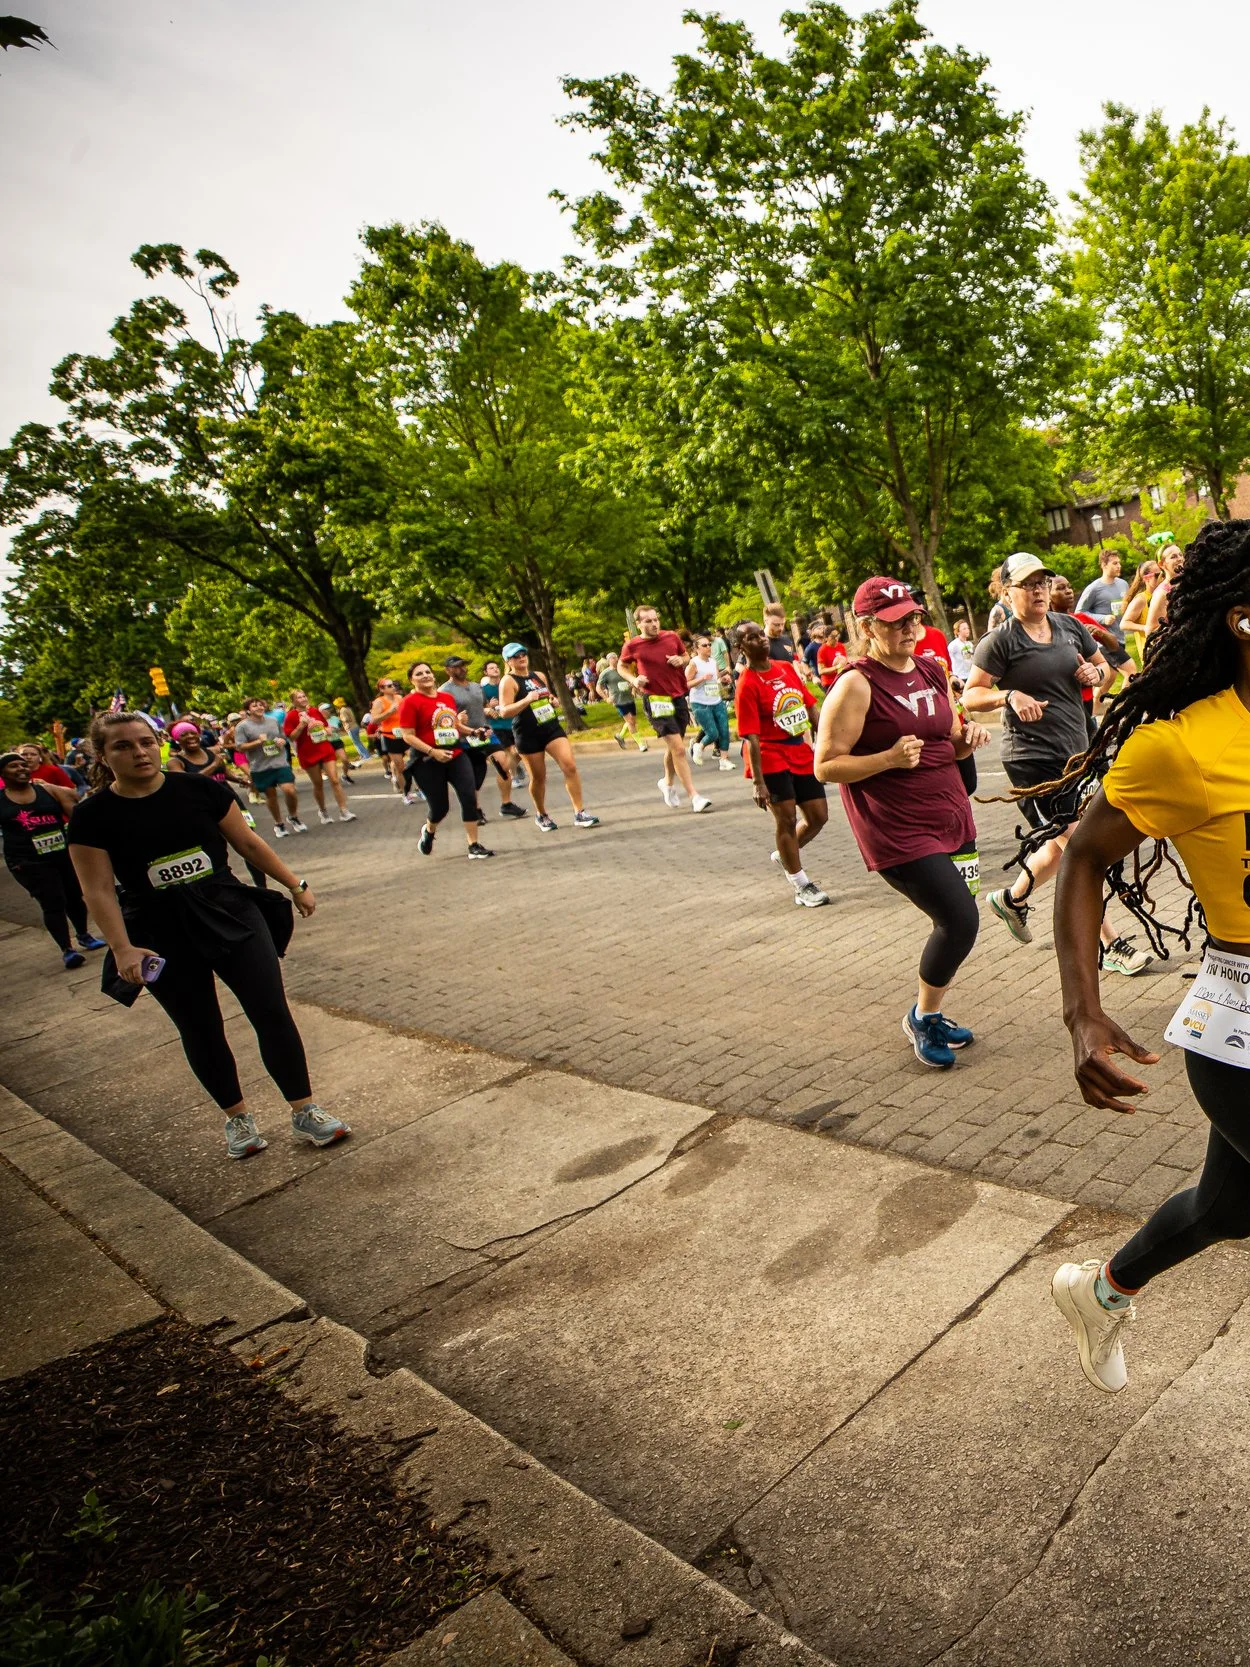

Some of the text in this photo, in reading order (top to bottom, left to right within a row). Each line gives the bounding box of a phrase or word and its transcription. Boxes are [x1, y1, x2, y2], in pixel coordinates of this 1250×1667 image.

[880, 584, 907, 600] VT
[894, 686, 938, 718] VT
[779, 710, 807, 727] 13728
[158, 858, 205, 882] 8892
[1206, 963, 1218, 976] IN
[1236, 961, 1250, 970] WITH
[1189, 1019, 1206, 1031] VCU
